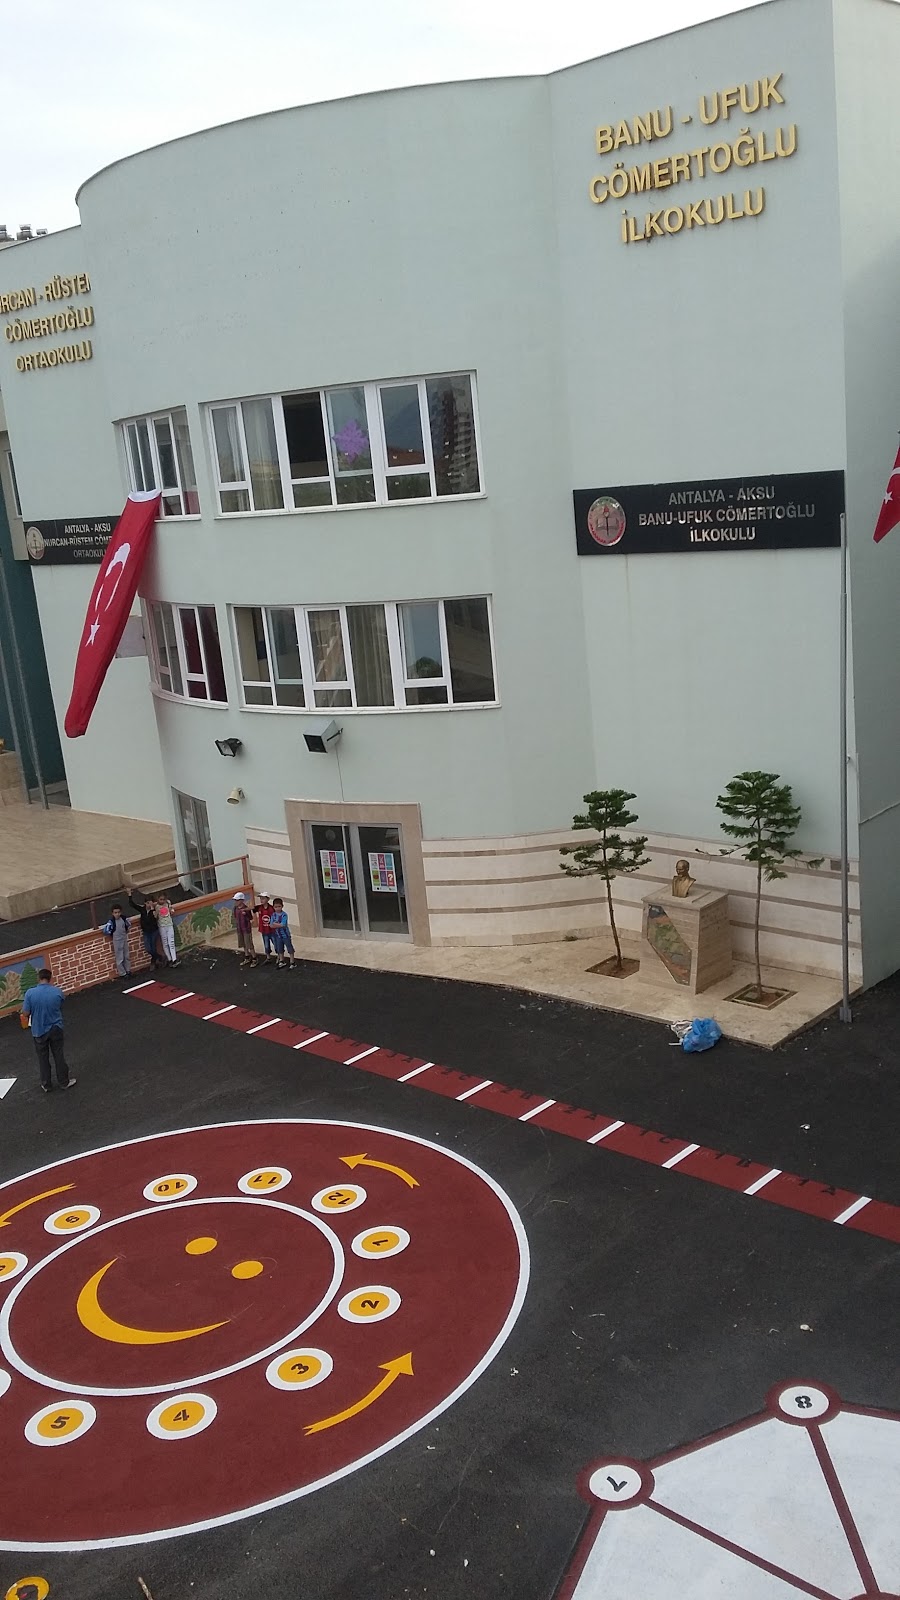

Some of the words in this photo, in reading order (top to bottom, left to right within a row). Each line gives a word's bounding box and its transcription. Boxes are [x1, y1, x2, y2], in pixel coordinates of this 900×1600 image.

[595, 105, 674, 154] BANU
[699, 72, 785, 125] UFUK
[588, 123, 798, 204] CÖMERTOĞLU
[621, 187, 764, 243] İLKOKULU
[0, 287, 37, 314] RCAN
[4, 304, 95, 343] CÖMERTOĞLU
[16, 340, 93, 372] ORTAOKULU
[668, 489, 725, 506] ANTALYA
[736, 486, 776, 501] AKSU
[638, 508, 714, 526] BANU-UFUK
[715, 501, 816, 522] CÖMERTOĞLU
[64, 524, 90, 534] ANTALYA
[94, 523, 111, 532] AKSU
[689, 526, 756, 543] İLKOKULU
[328, 1191, 351, 1206] 12
[372, 1239, 389, 1247] 1
[360, 1299, 380, 1310] 2
[290, 1362, 310, 1376] 3
[794, 1395, 813, 1410] 8
[50, 1415, 71, 1430] 5
[172, 1408, 190, 1422] 4
